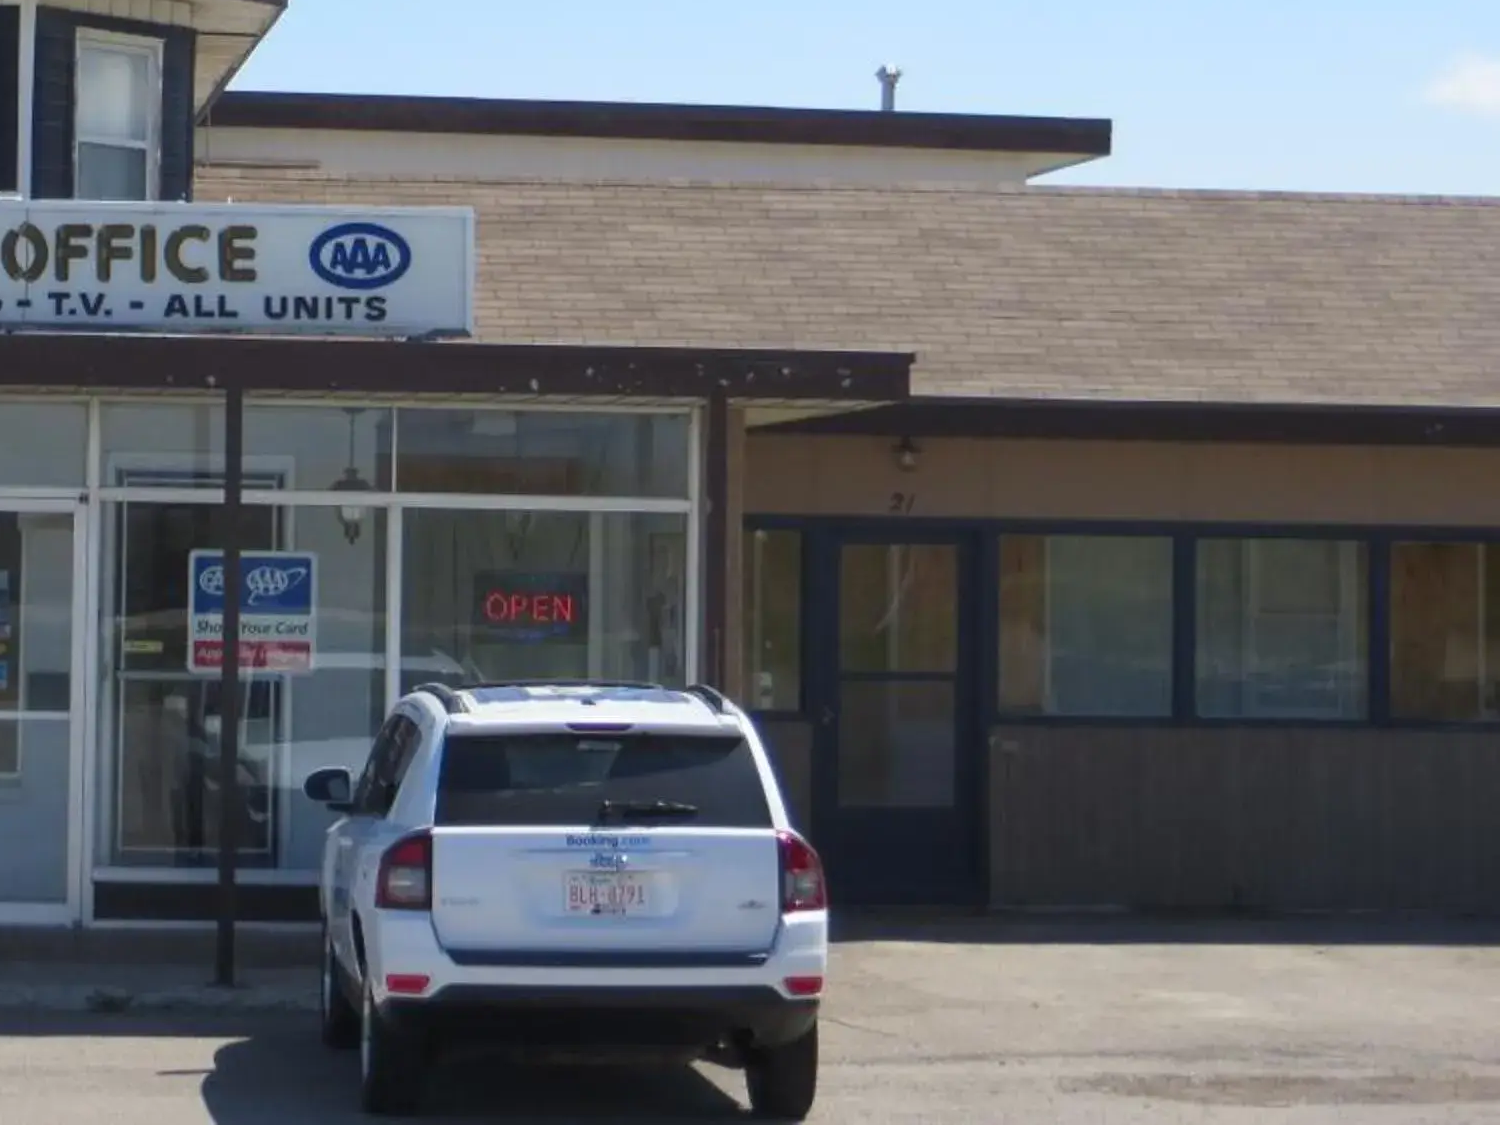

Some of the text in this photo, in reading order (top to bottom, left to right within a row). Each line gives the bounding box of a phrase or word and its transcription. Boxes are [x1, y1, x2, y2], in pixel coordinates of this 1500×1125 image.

[1, 222, 258, 283] OFFICE
[328, 237, 392, 275] AAA
[47, 293, 113, 317] T.V.
[163, 293, 239, 319] ALL
[263, 294, 388, 322] UNITS
[486, 592, 572, 622] OPEN
[196, 619, 222, 635] Sho
[275, 621, 308, 636] Card
